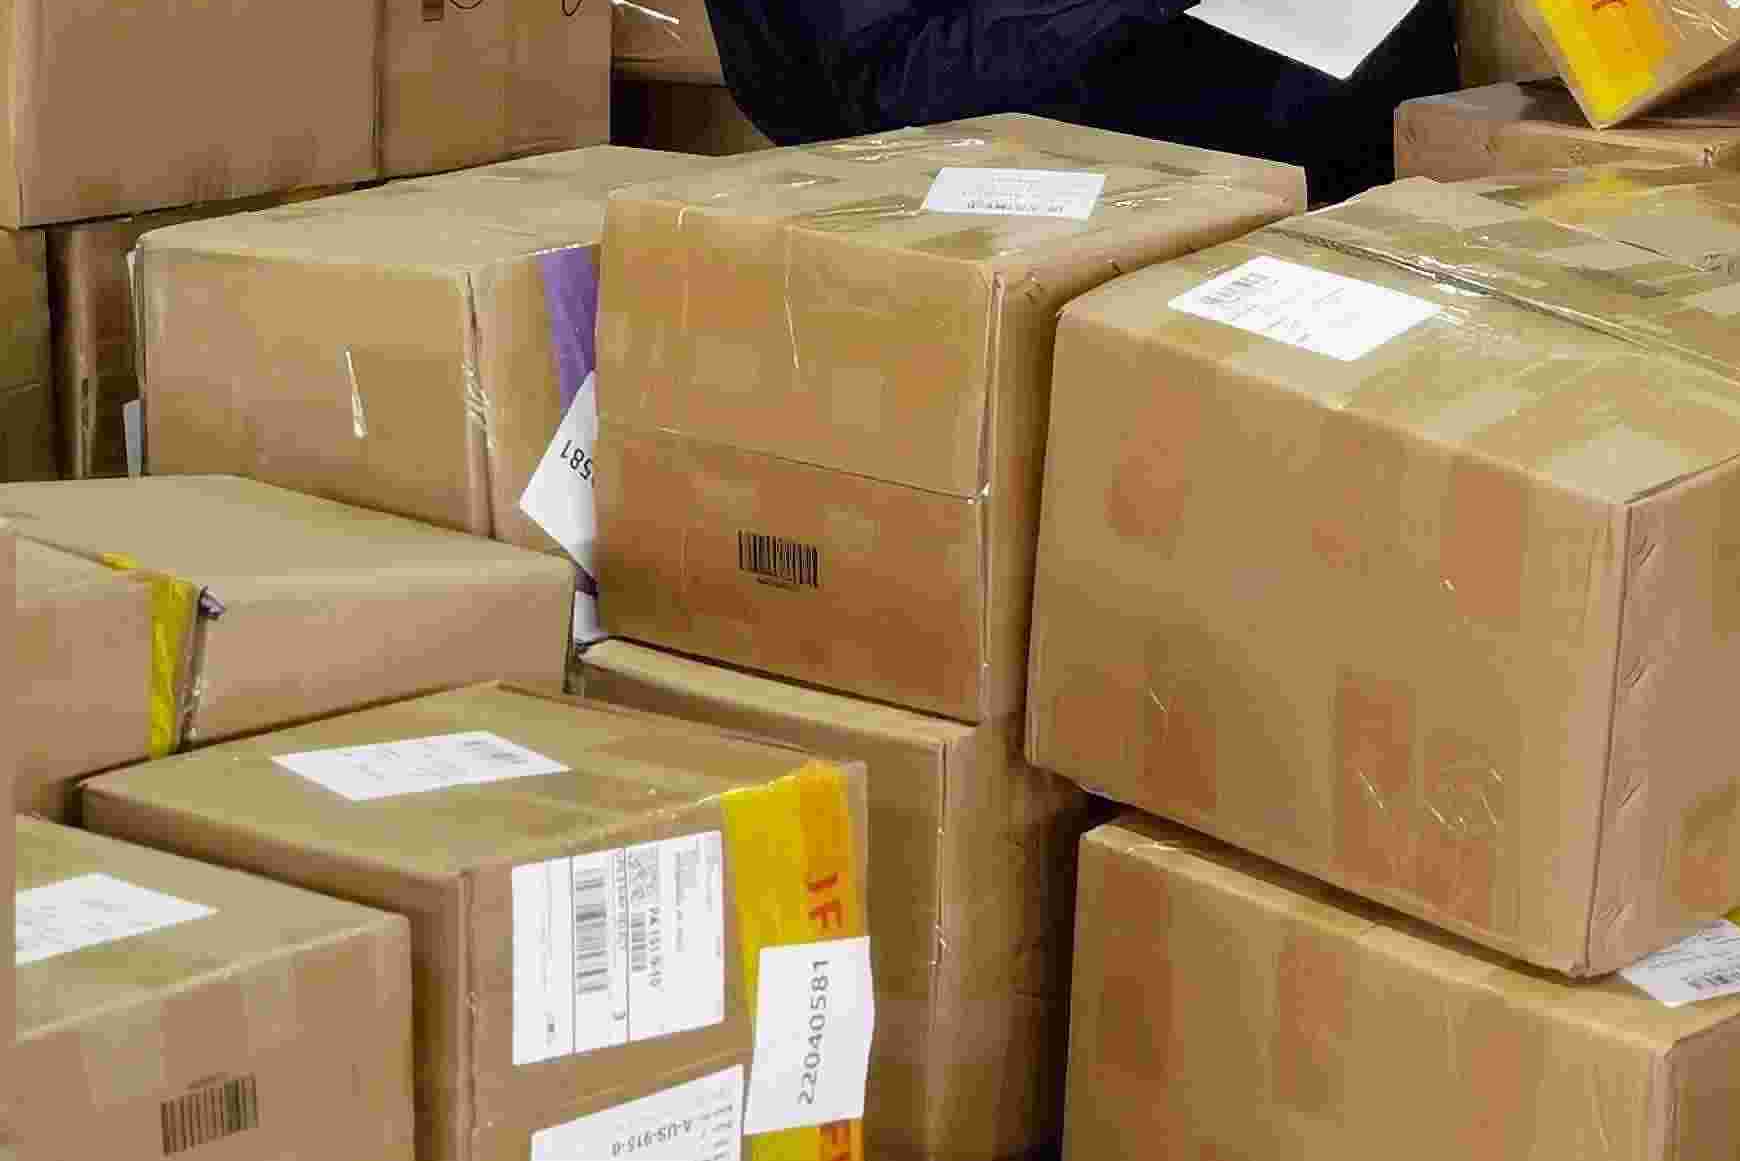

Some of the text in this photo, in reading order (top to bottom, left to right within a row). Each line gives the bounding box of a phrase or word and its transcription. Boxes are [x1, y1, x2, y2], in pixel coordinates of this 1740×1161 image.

[558, 438, 594, 482] 581
[803, 870, 844, 929] JF
[797, 957, 830, 1105] 22040581
